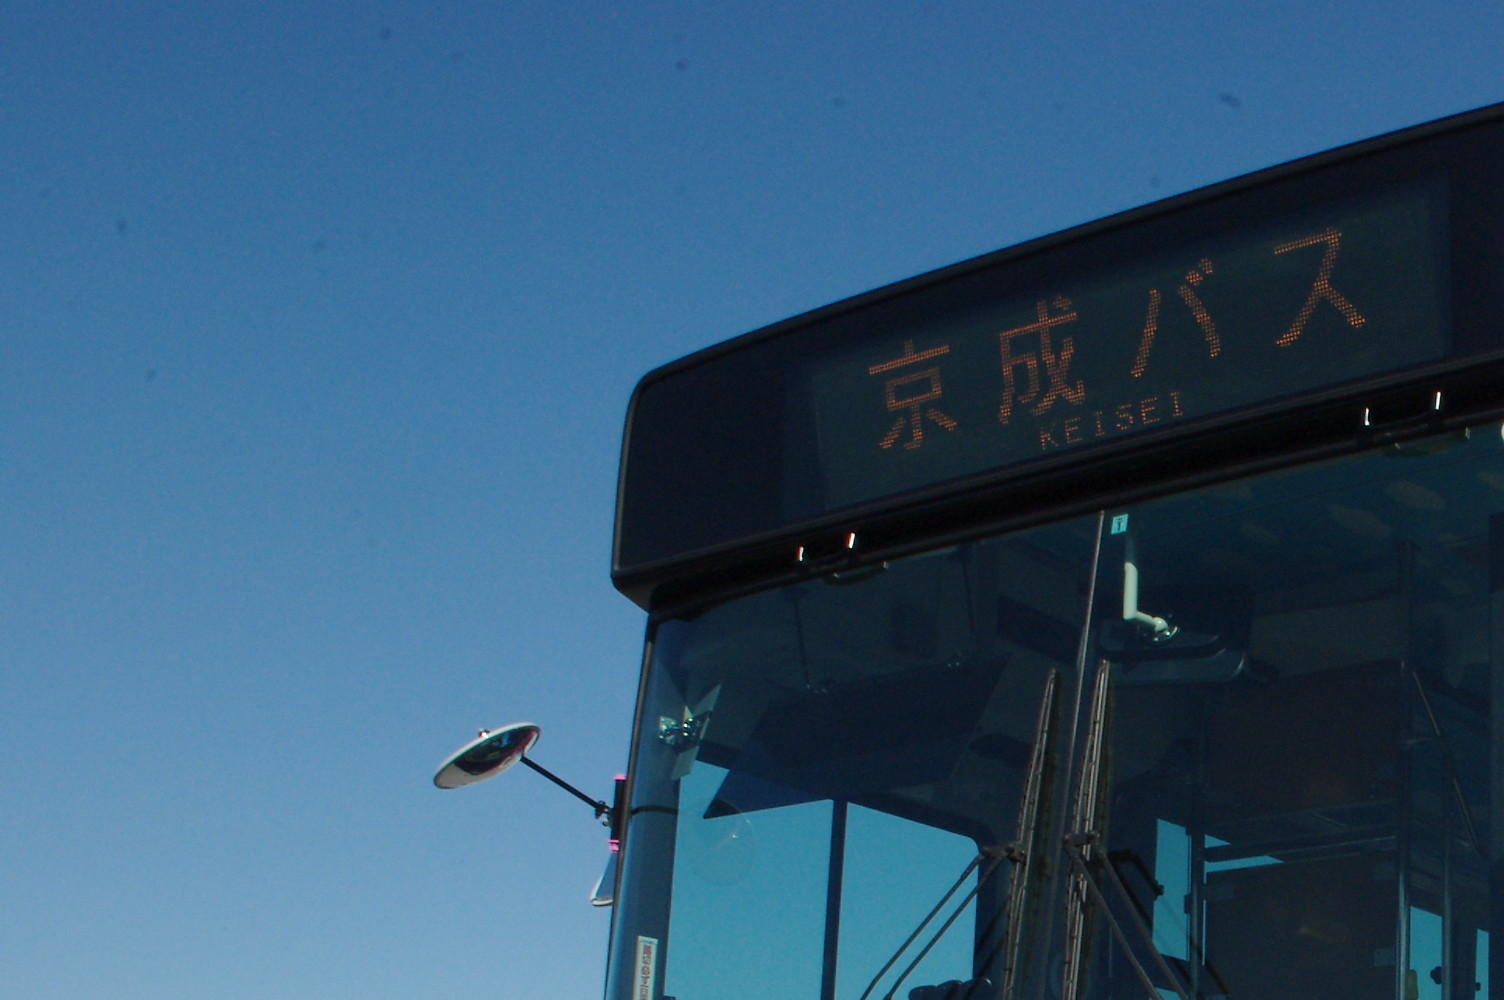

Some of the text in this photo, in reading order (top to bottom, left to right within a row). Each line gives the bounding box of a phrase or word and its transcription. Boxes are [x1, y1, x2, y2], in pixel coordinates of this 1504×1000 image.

[869, 227, 1366, 450] 京成バス
[1039, 391, 1184, 450] KEISEI
